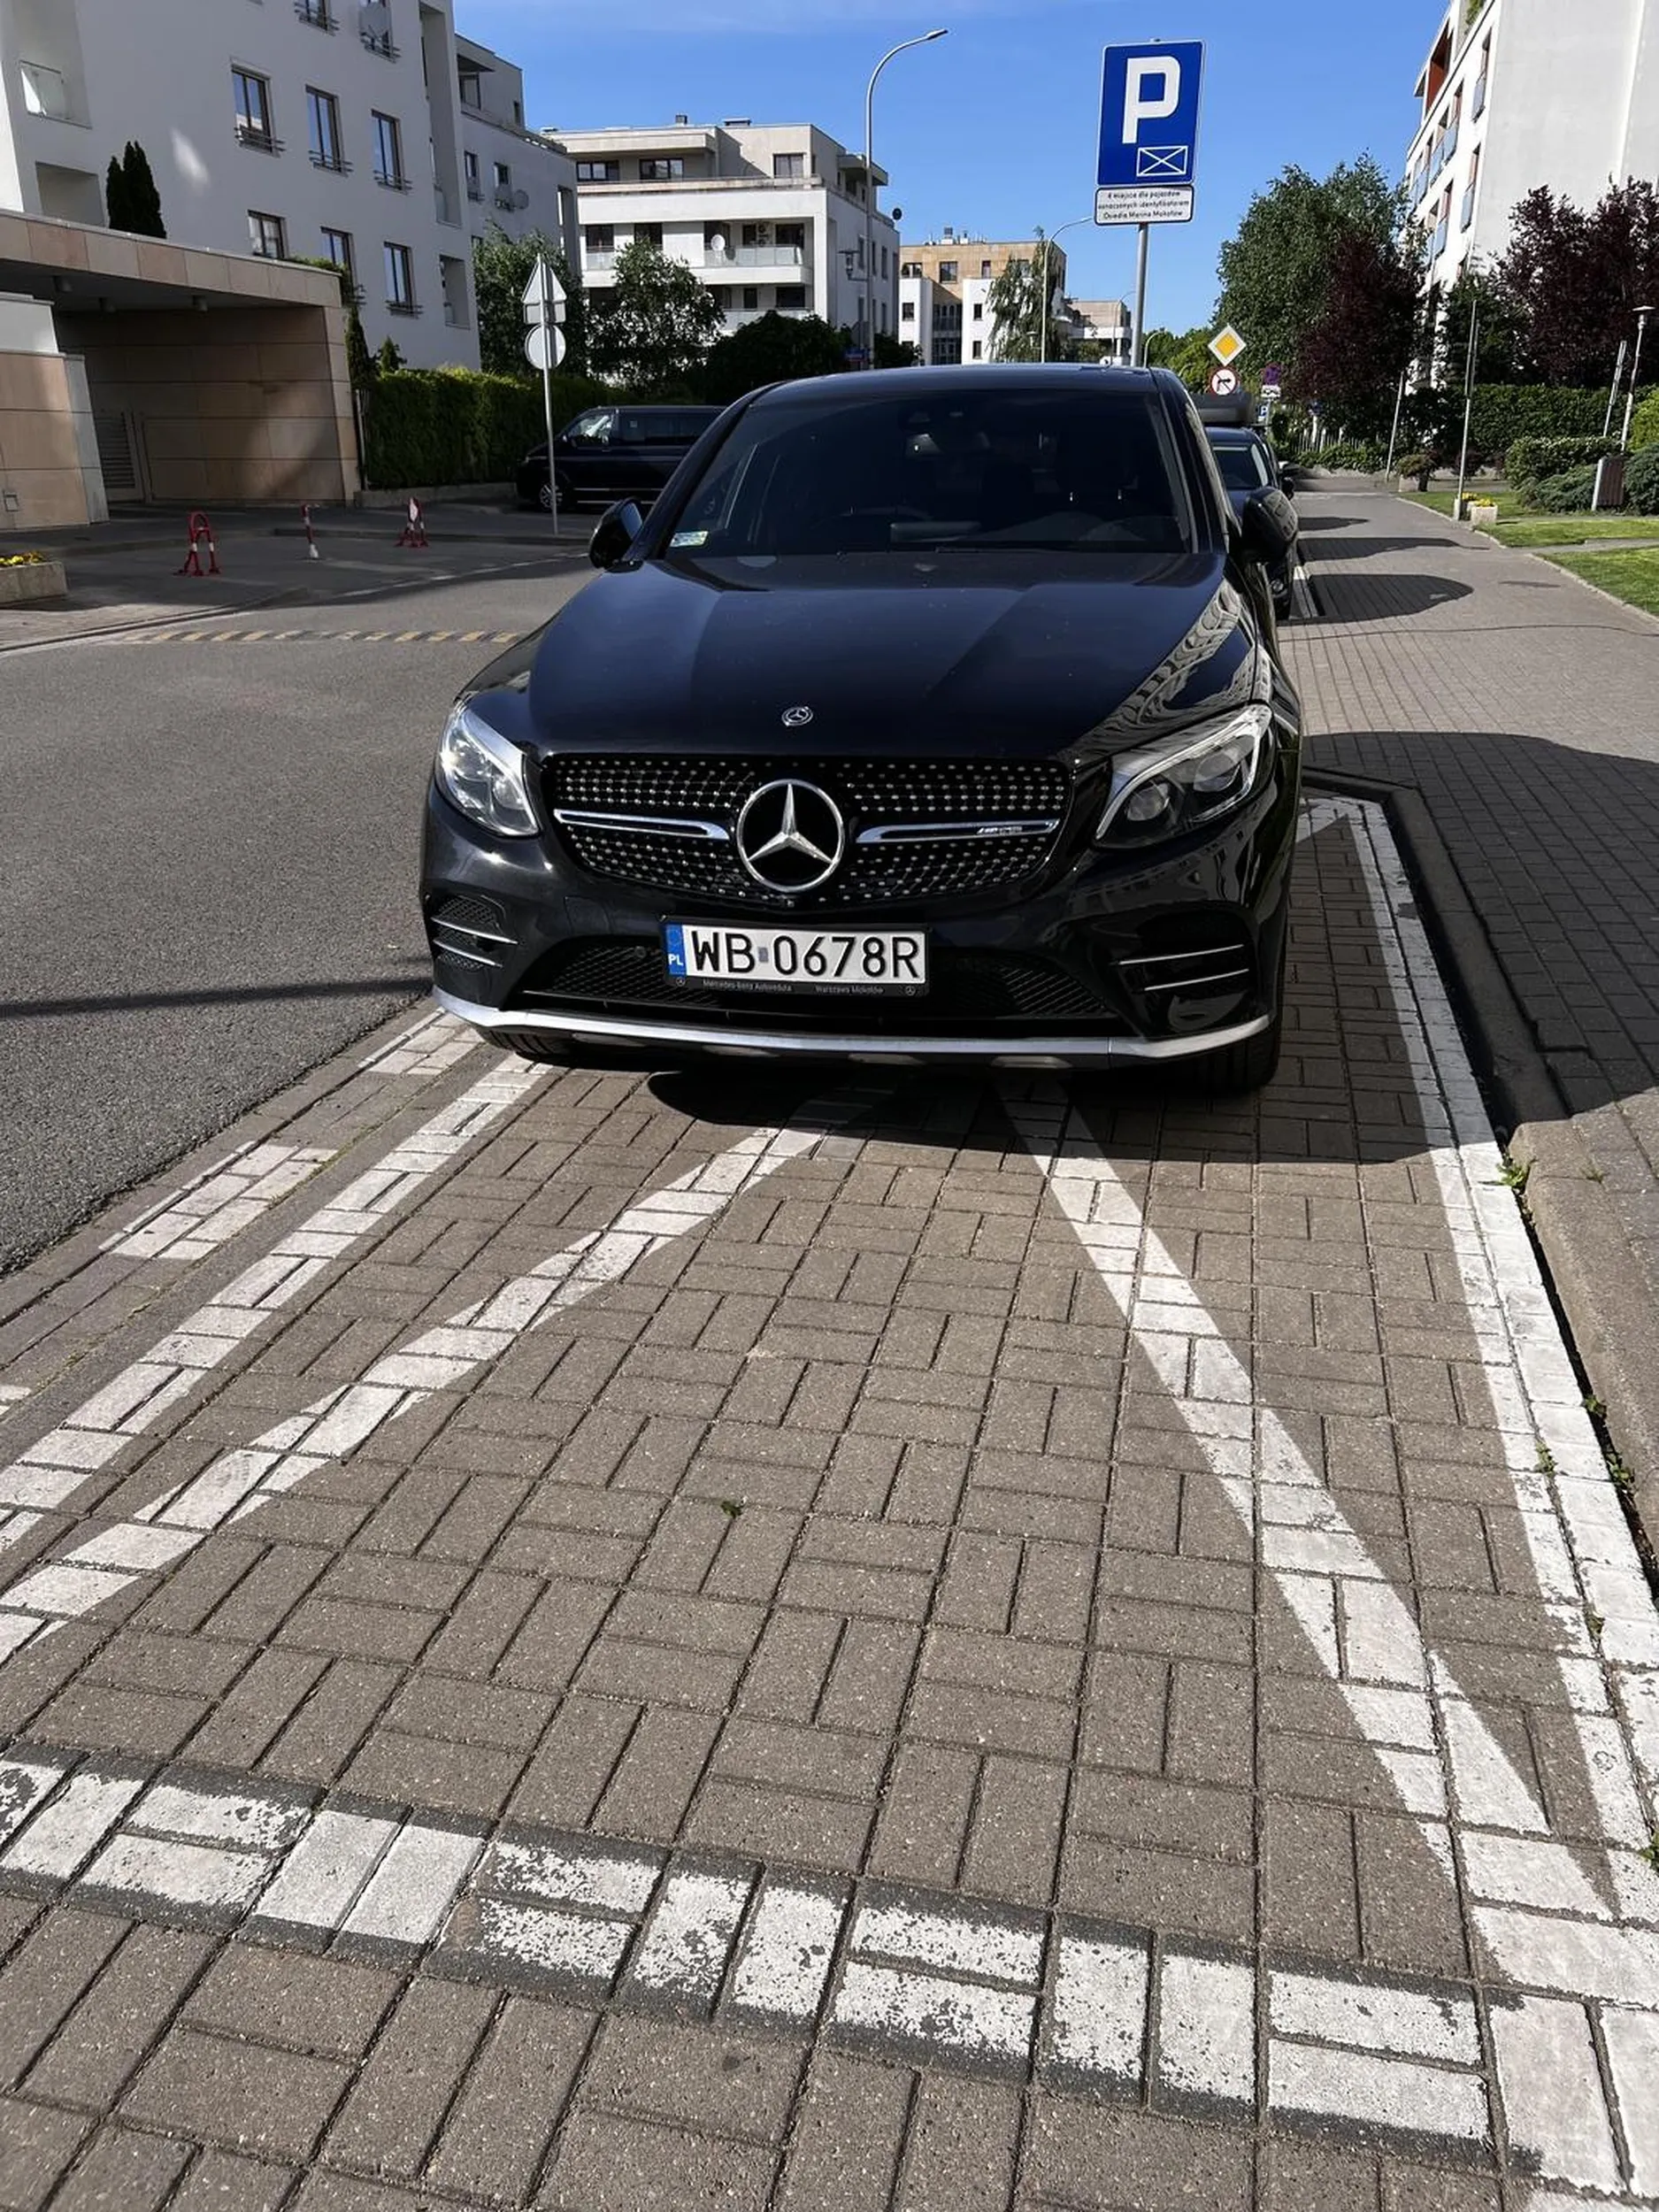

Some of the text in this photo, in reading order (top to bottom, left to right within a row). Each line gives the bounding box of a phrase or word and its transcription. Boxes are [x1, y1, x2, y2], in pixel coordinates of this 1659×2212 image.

[1122, 56, 1180, 143] P
[668, 954, 684, 966] PL
[691, 930, 920, 978] WB 0678R
